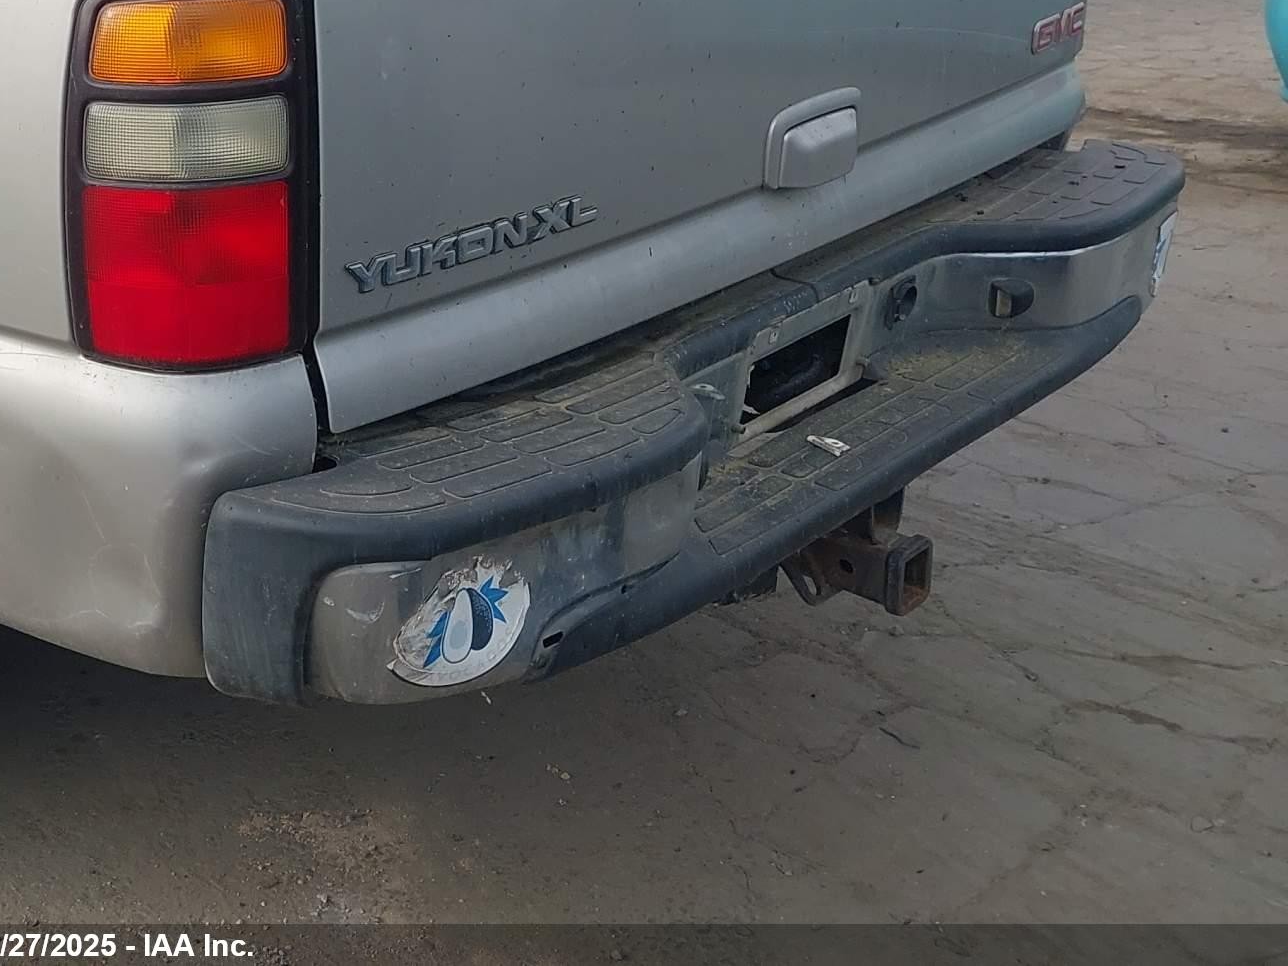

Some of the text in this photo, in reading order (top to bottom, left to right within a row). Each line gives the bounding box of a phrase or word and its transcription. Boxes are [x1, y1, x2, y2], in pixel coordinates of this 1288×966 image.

[1031, 2, 1085, 54] GMC
[345, 194, 598, 294] YUKON XL
